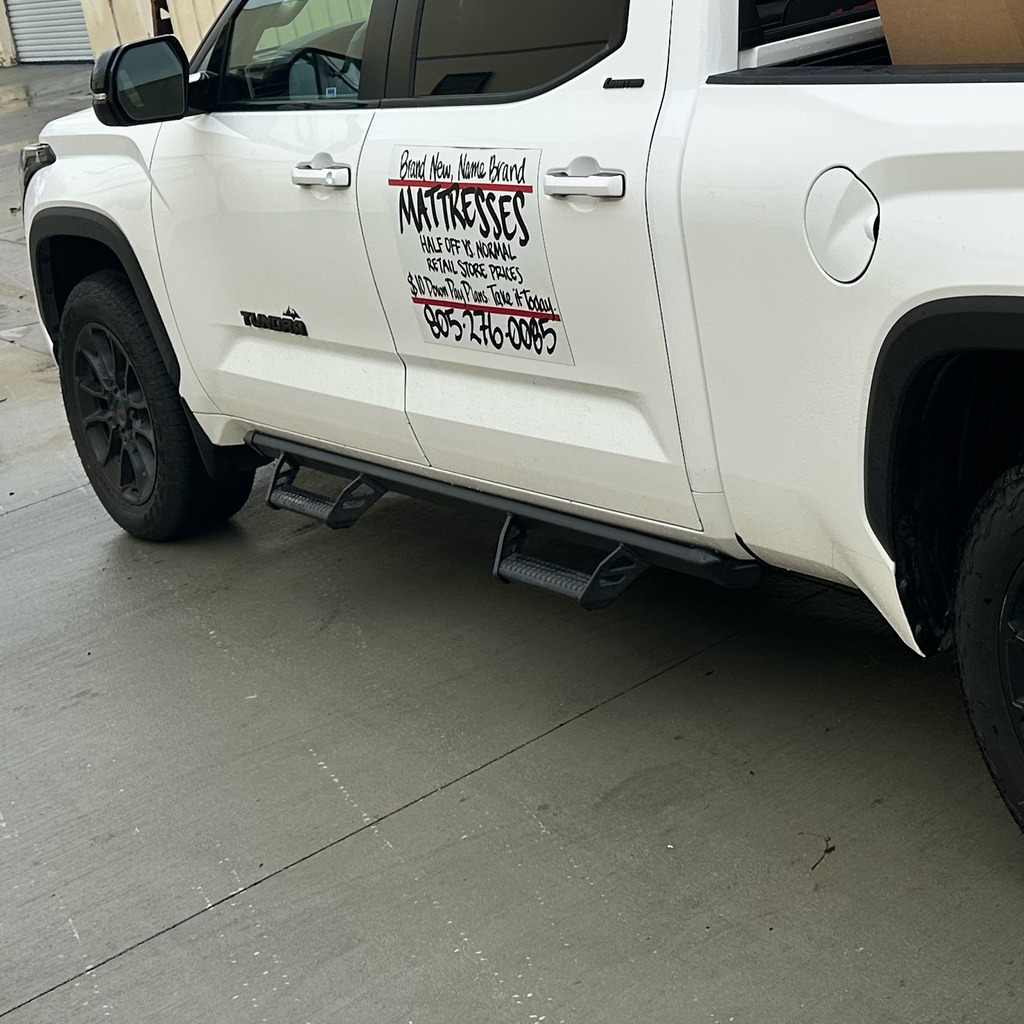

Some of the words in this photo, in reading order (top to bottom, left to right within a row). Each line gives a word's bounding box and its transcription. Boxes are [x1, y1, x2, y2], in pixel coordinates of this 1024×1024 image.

[400, 149, 426, 181] Brand
[458, 153, 487, 180] Name
[489, 154, 526, 184] Brand
[399, 183, 530, 247] MATTRESSES
[420, 234, 443, 255] HALF
[444, 236, 461, 256] OFF
[475, 240, 517, 261] NORMAL
[426, 257, 458, 275] RETAIL
[457, 259, 488, 279] STORE
[488, 263, 524, 285] PRICES
[407, 271, 426, 297] $10
[424, 276, 449, 299] Down
[445, 277, 467, 308] Pay
[487, 283, 514, 308] Take
[512, 288, 523, 308] it
[240, 309, 309, 337] TUNDRA
